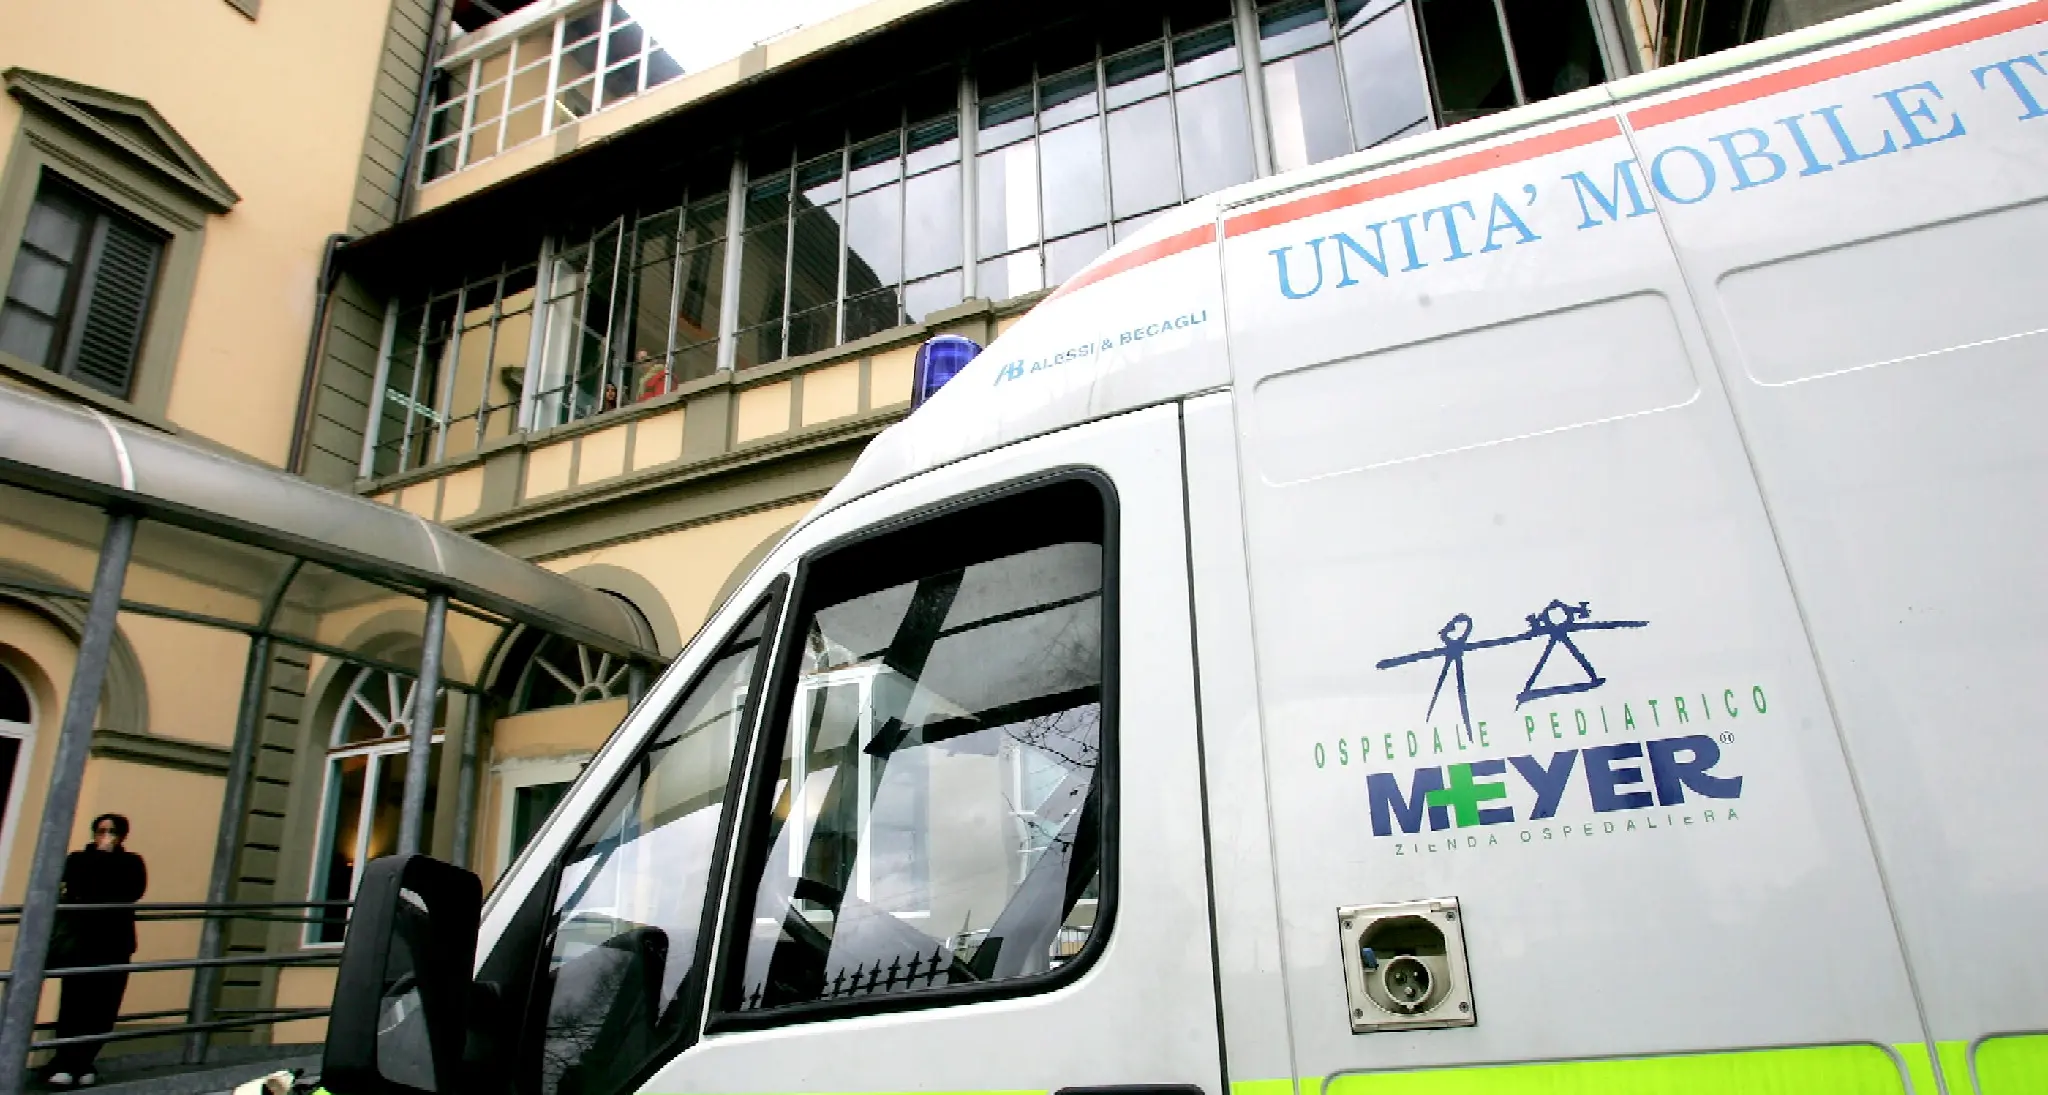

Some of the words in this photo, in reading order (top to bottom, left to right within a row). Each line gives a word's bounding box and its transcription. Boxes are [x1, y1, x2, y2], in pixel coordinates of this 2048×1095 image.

[1564, 80, 1968, 229] MOBILE
[1969, 50, 2048, 121] T
[1030, 342, 1095, 374] ALESSI
[1101, 338, 1114, 351] &
[1119, 309, 1208, 345] BECAGLI
[1314, 721, 1490, 769] OSPEDALE
[1524, 684, 1768, 742] PEDIATRICO
[1366, 733, 1743, 837] MEYER
[1520, 808, 1739, 844] OSPEDALIERA
